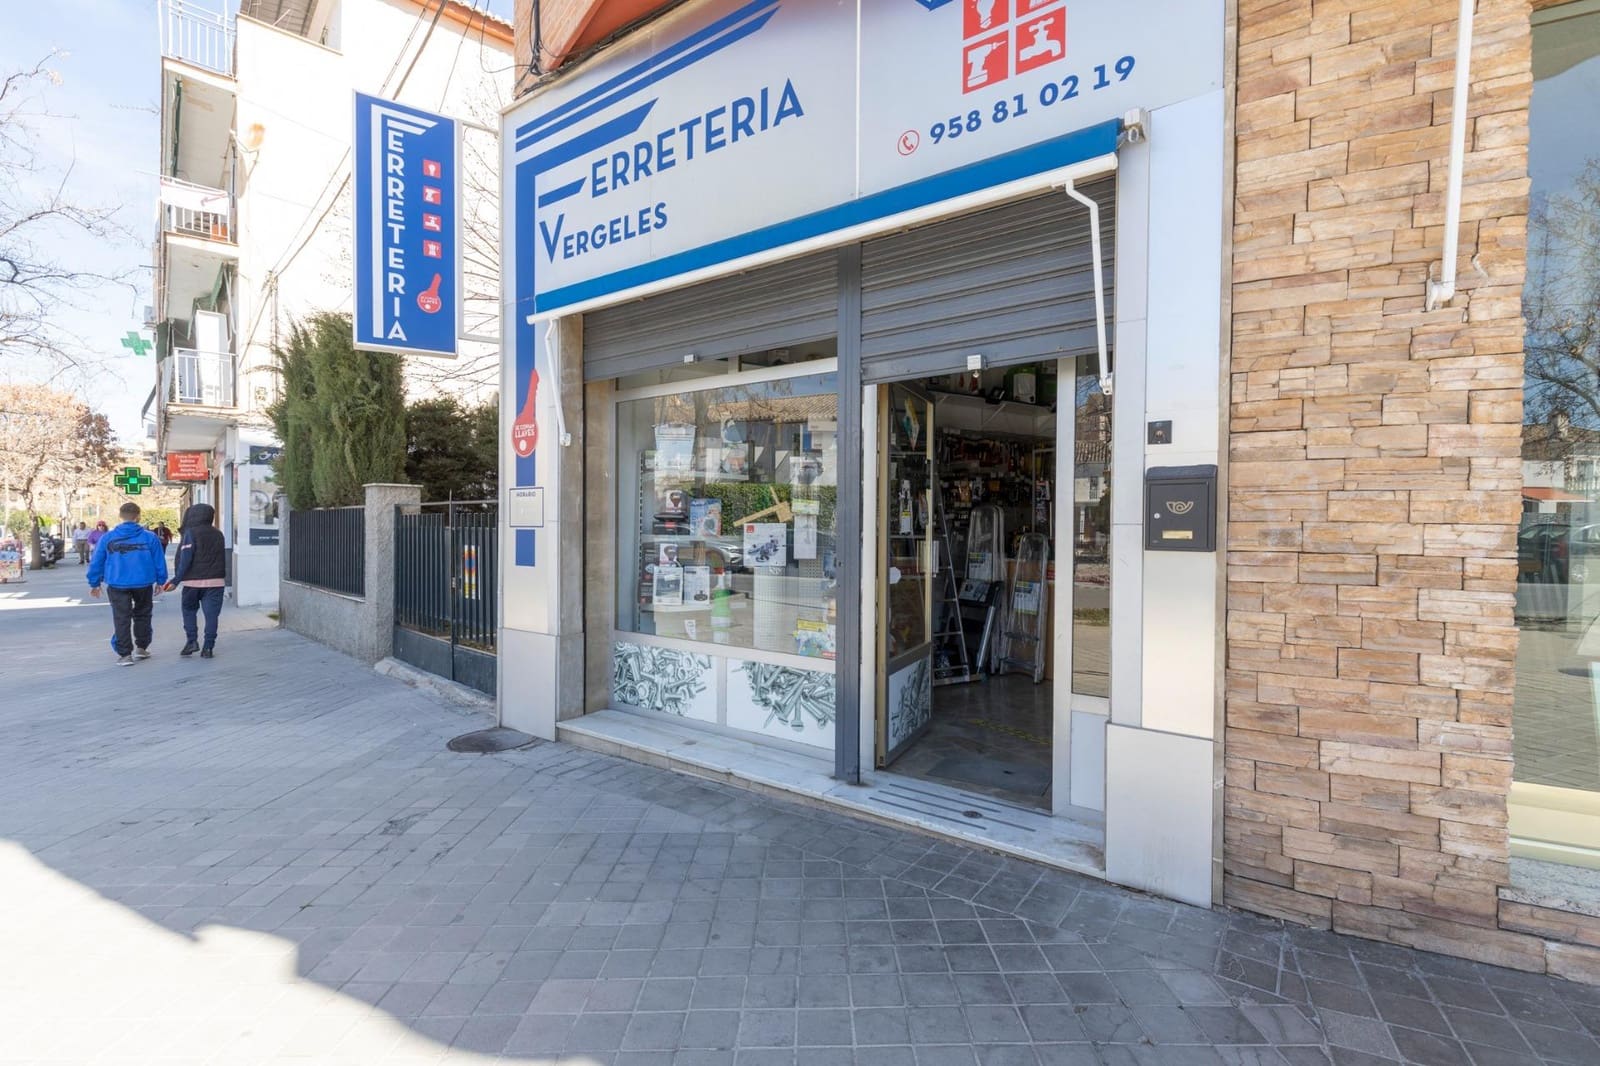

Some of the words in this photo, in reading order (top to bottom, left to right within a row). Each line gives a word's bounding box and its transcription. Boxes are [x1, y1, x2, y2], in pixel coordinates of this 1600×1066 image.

[929, 110, 981, 145] 958
[992, 93, 1028, 124] 81
[1039, 75, 1079, 107] 02
[1093, 55, 1136, 90] 19
[539, 202, 667, 264] VERGELES
